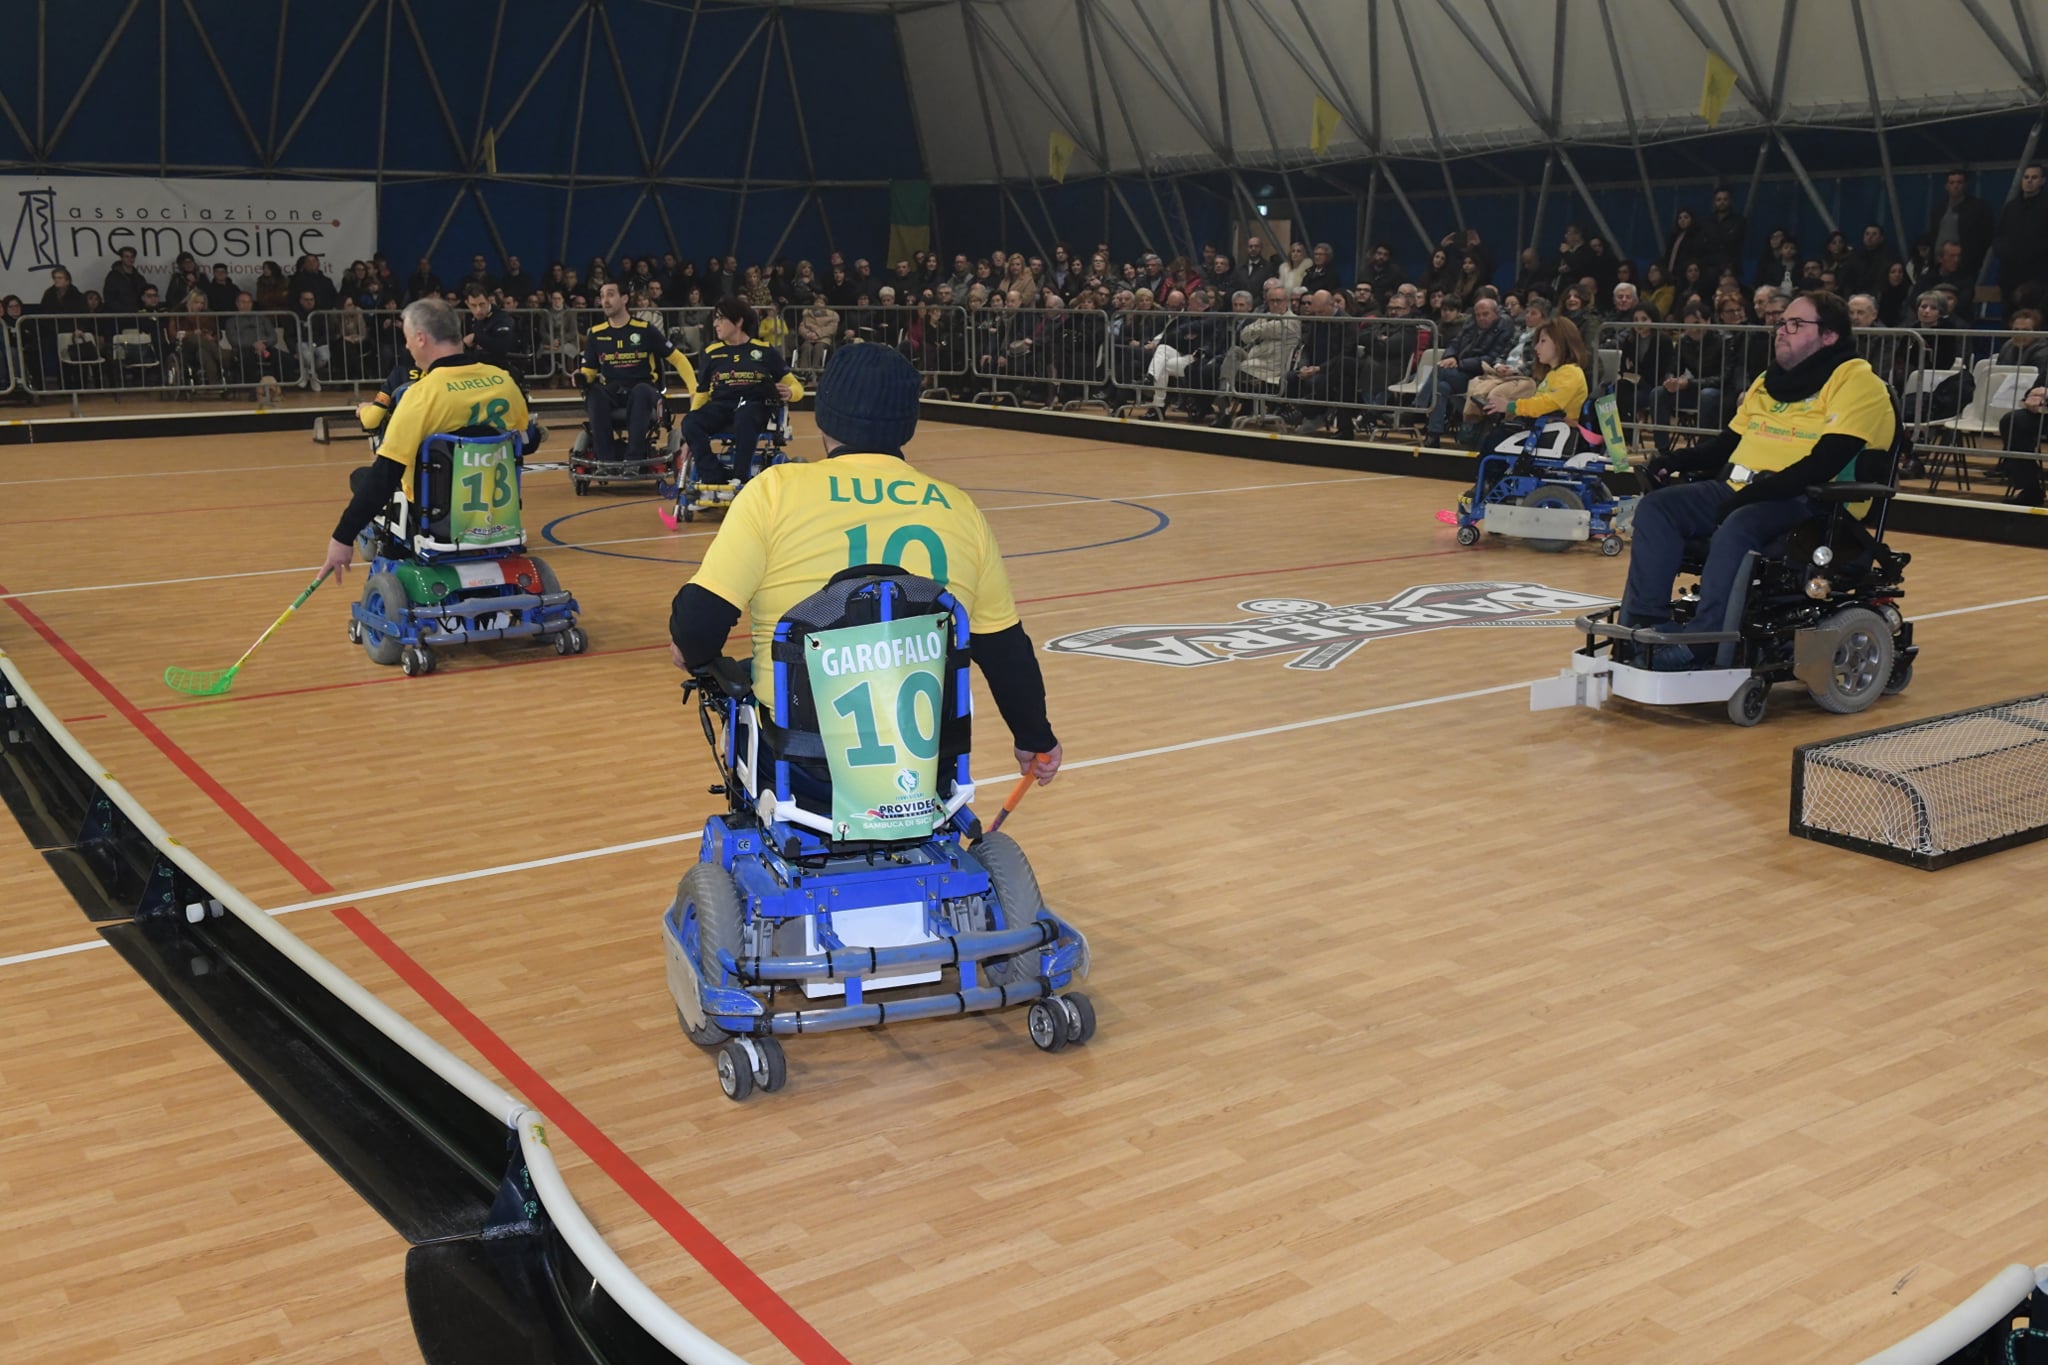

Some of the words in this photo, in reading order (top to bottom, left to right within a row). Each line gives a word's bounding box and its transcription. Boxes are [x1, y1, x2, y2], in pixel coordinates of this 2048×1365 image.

[69, 204, 323, 221] associazione
[446, 375, 504, 392] AURELIO
[461, 462, 512, 512] 18
[829, 476, 952, 510] LUCA
[844, 523, 950, 588] 10
[821, 631, 942, 677] GAROFALO
[832, 669, 943, 768] 10
